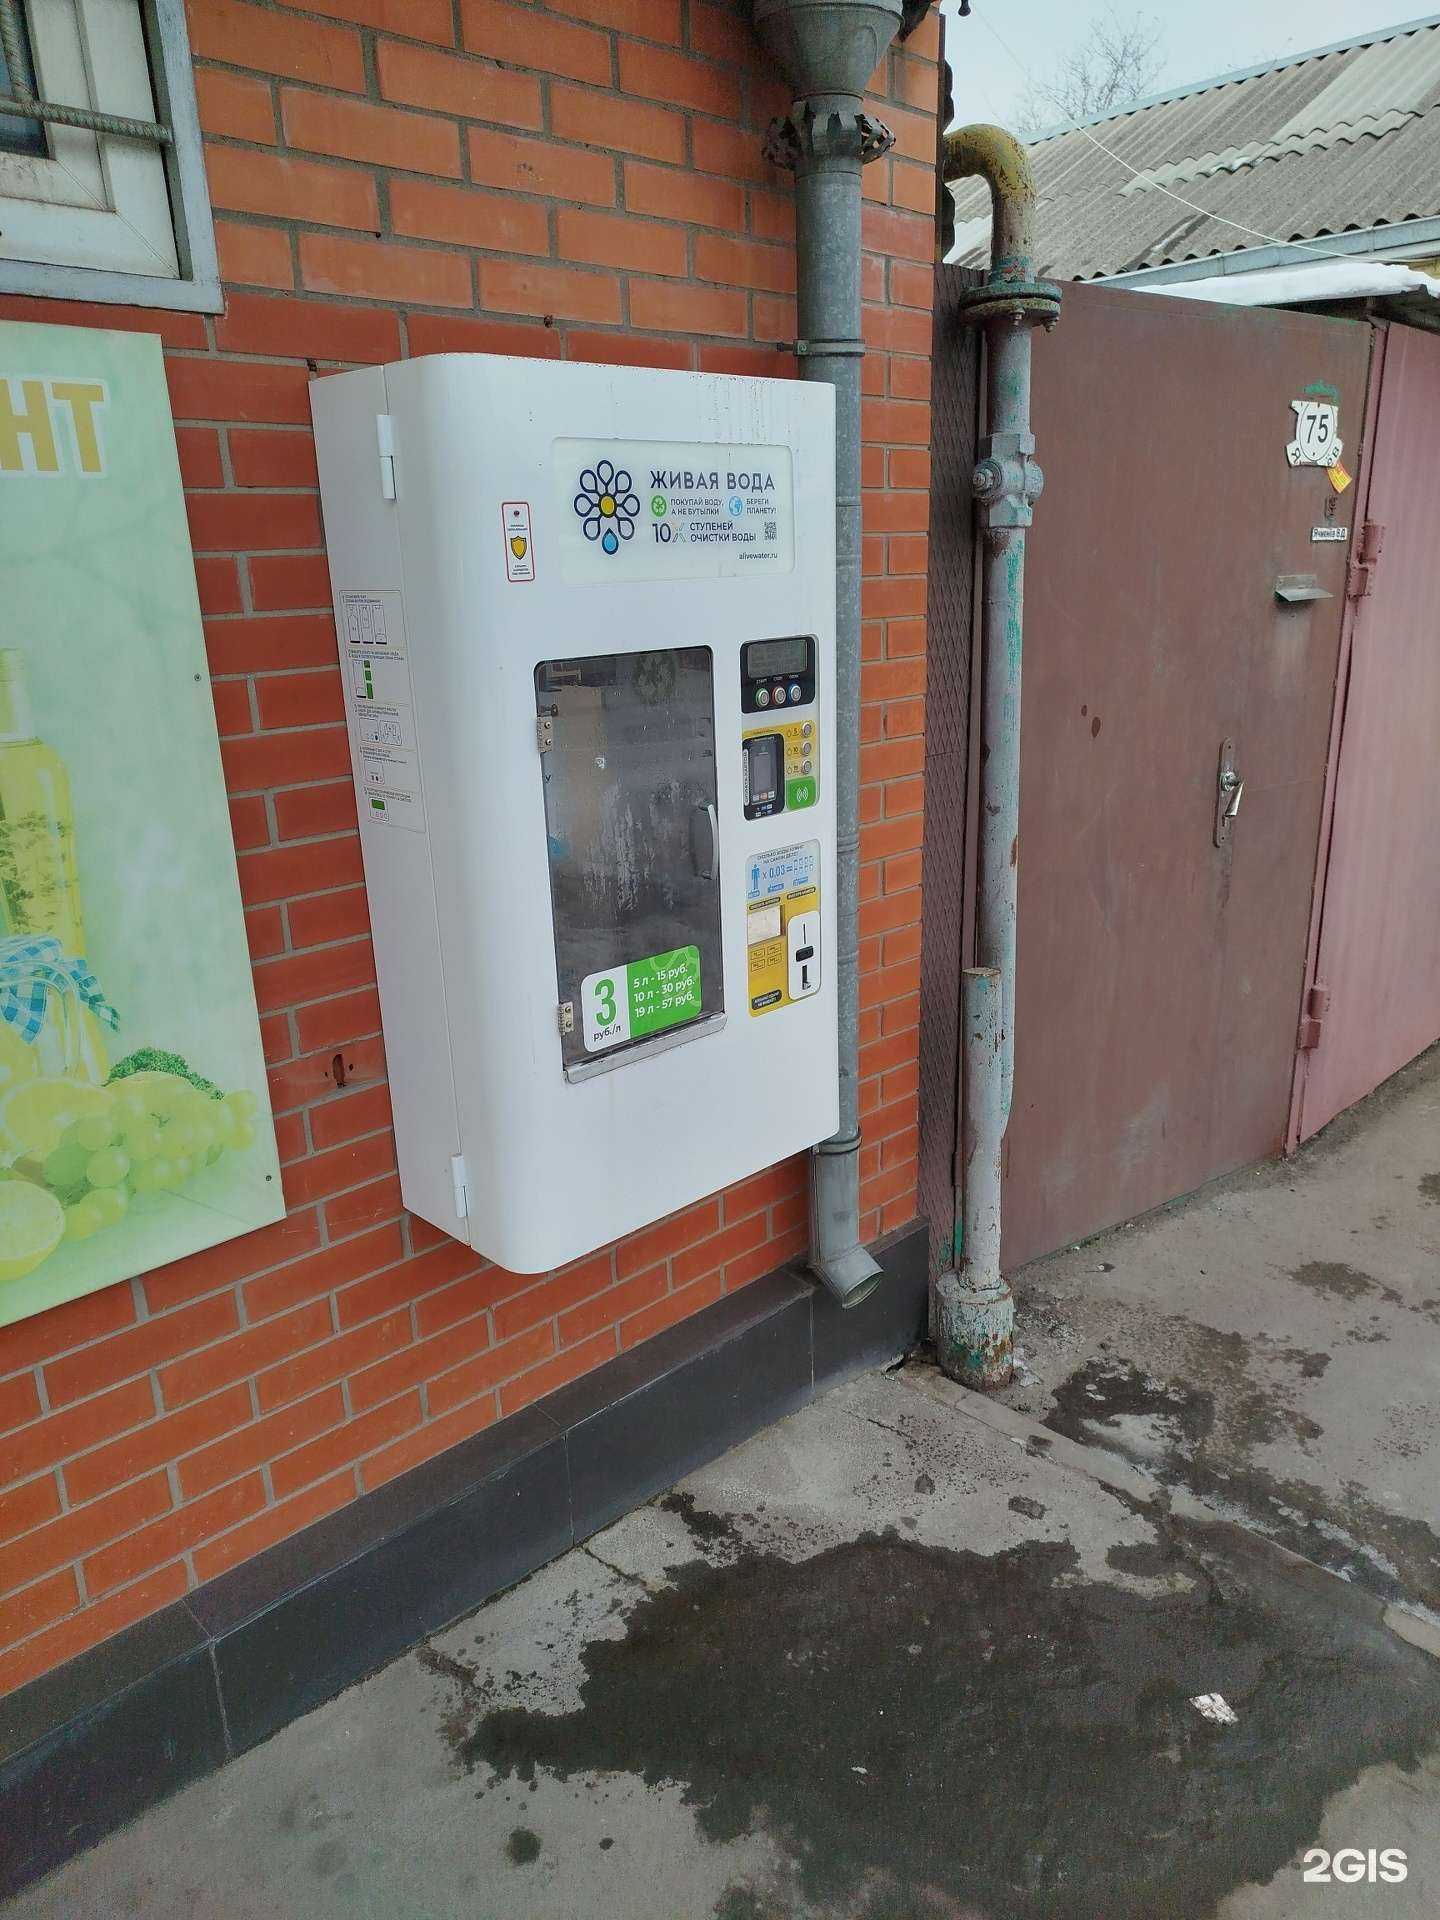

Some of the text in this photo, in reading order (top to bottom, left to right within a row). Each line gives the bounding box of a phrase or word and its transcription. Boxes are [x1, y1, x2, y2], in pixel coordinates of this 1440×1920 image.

[1306, 414, 1329, 443] 75
[650, 470, 775, 493] ЖИВАЯ ВОДА
[670, 497, 703, 506] ПОКУПАЙ
[689, 521, 734, 531] СТУПЕНЕЙ
[690, 533, 757, 543] ОЧИСТКИ ВОДЫ
[739, 552, 778, 560] alivewater.ru
[633, 978, 640, 988] 5
[641, 977, 649, 986] л
[656, 970, 667, 981] 15
[668, 963, 688, 979] руб.
[634, 992, 645, 1003] 10
[646, 991, 654, 1000] л
[661, 984, 674, 995] 30
[675, 975, 695, 992] руб.
[594, 978, 617, 1027] 3
[634, 1007, 645, 1018] 19
[647, 1005, 654, 1014] л
[662, 998, 673, 1009] 57
[675, 992, 695, 1006] руб.
[593, 1024, 621, 1042] руб./л
